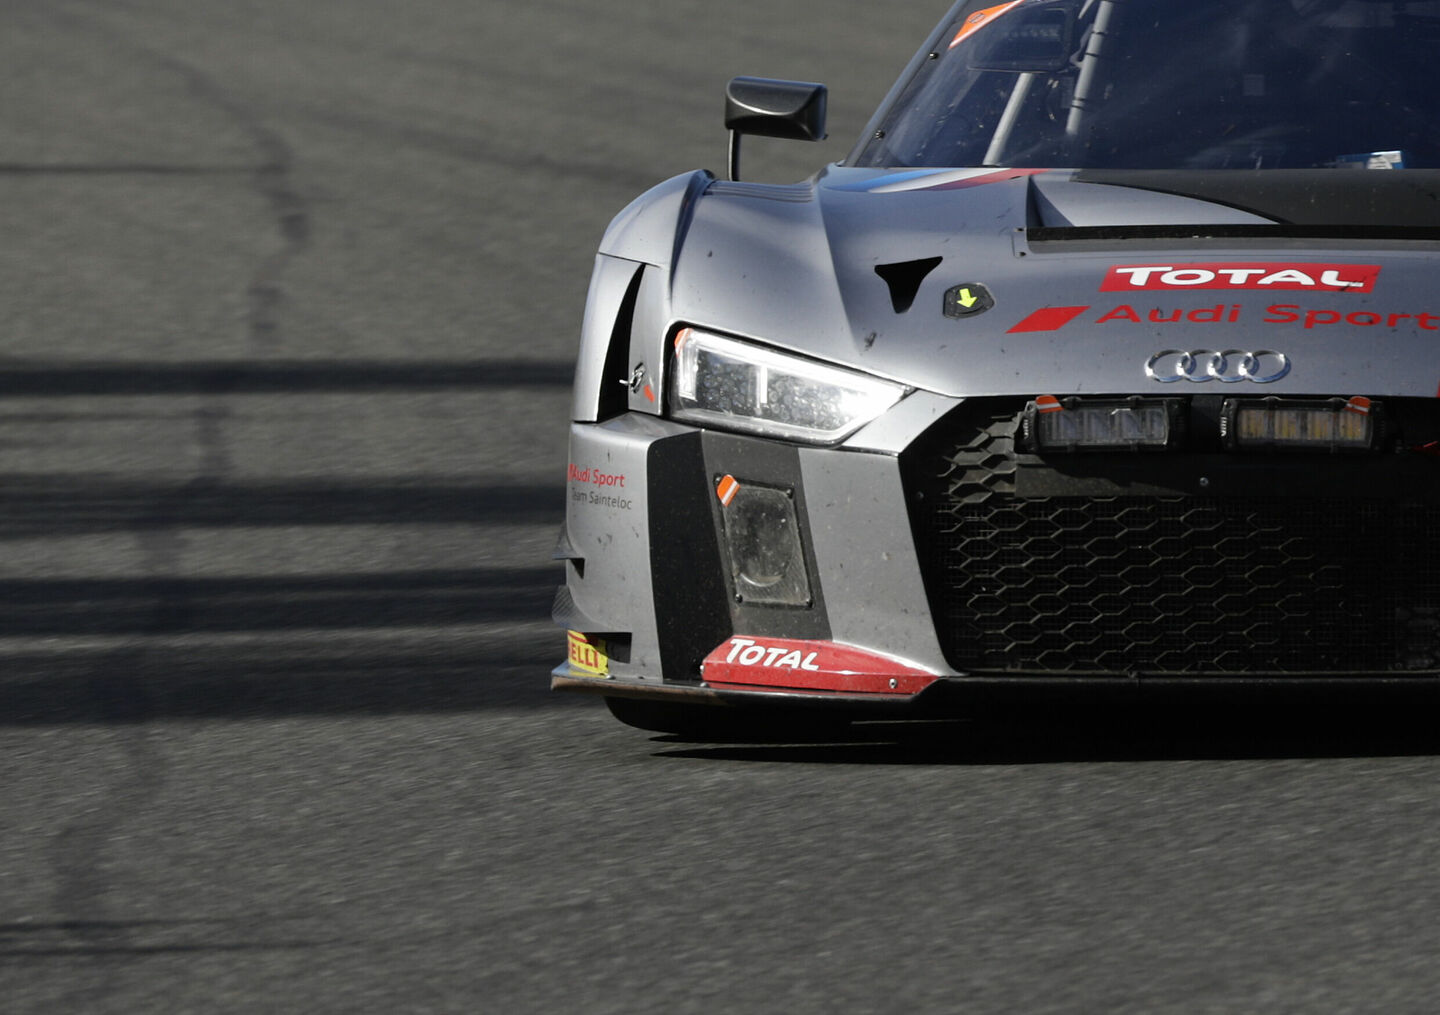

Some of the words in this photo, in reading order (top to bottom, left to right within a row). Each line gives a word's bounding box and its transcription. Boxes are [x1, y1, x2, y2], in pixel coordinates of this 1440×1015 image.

[1115, 266, 1365, 288] TOTAL
[1094, 303, 1242, 324] Audi
[592, 469, 625, 488] Sport
[589, 491, 632, 510] Sainteloc
[724, 638, 820, 671] TOTAL
